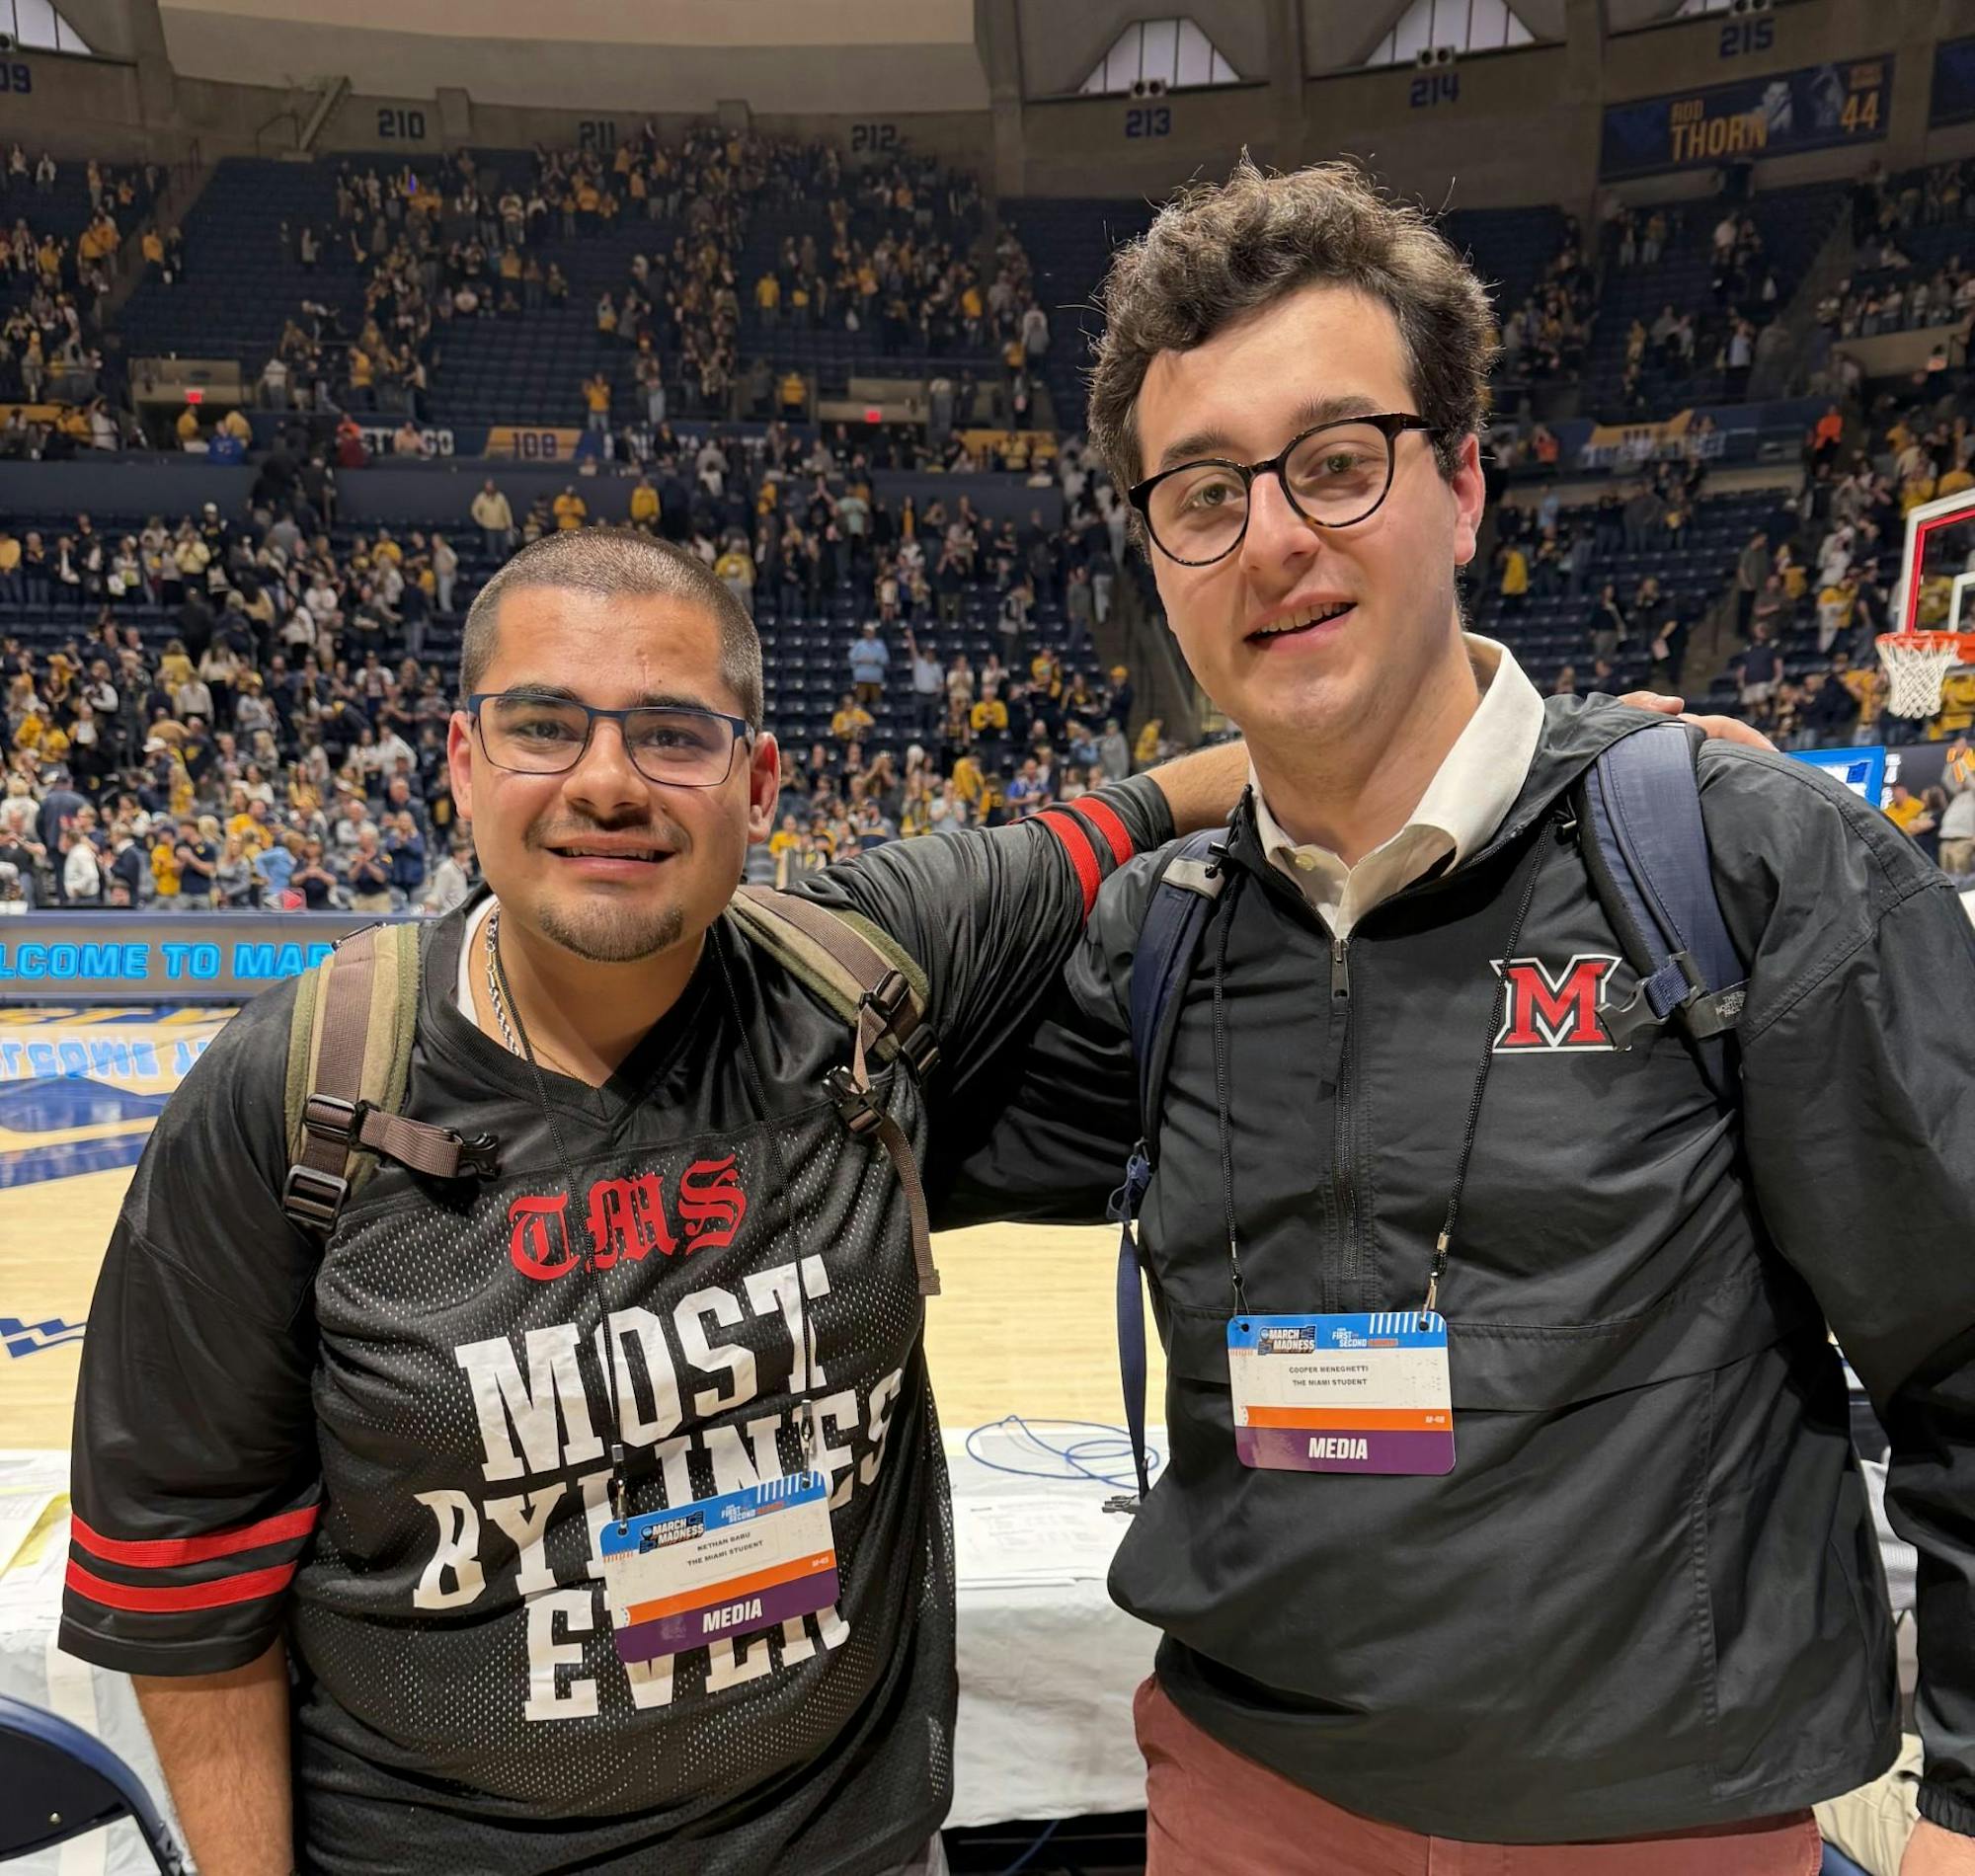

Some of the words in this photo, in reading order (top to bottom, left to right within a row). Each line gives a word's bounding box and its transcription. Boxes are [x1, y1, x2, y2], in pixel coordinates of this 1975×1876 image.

[1721, 18, 1775, 57] 215
[1411, 73, 1460, 108] 214
[378, 109, 427, 139] 210
[1126, 108, 1171, 137] 213
[1840, 91, 1880, 133] 44
[579, 120, 616, 152] 211
[852, 123, 897, 153] 212
[1671, 113, 1769, 164] THORN
[512, 432, 557, 459] 108
[161, 943, 221, 980] TO
[1489, 954, 1622, 1054] M
[508, 1154, 747, 1281] TMS
[1269, 1329, 1301, 1339] MARCH
[1273, 1339, 1315, 1350] MADNESS
[1331, 1331, 1352, 1340] FIRST
[1339, 1339, 1368, 1348] SECOND
[454, 1254, 831, 1481] MOST
[1308, 1437, 1368, 1459] MEDIA
[652, 1518, 687, 1535] MARCH
[658, 1524, 704, 1543] MADNESS
[687, 1558, 703, 1567] THE
[704, 1551, 728, 1562] MIAMI
[730, 1540, 764, 1556] STUDENT
[702, 1598, 762, 1633] MEDIA
